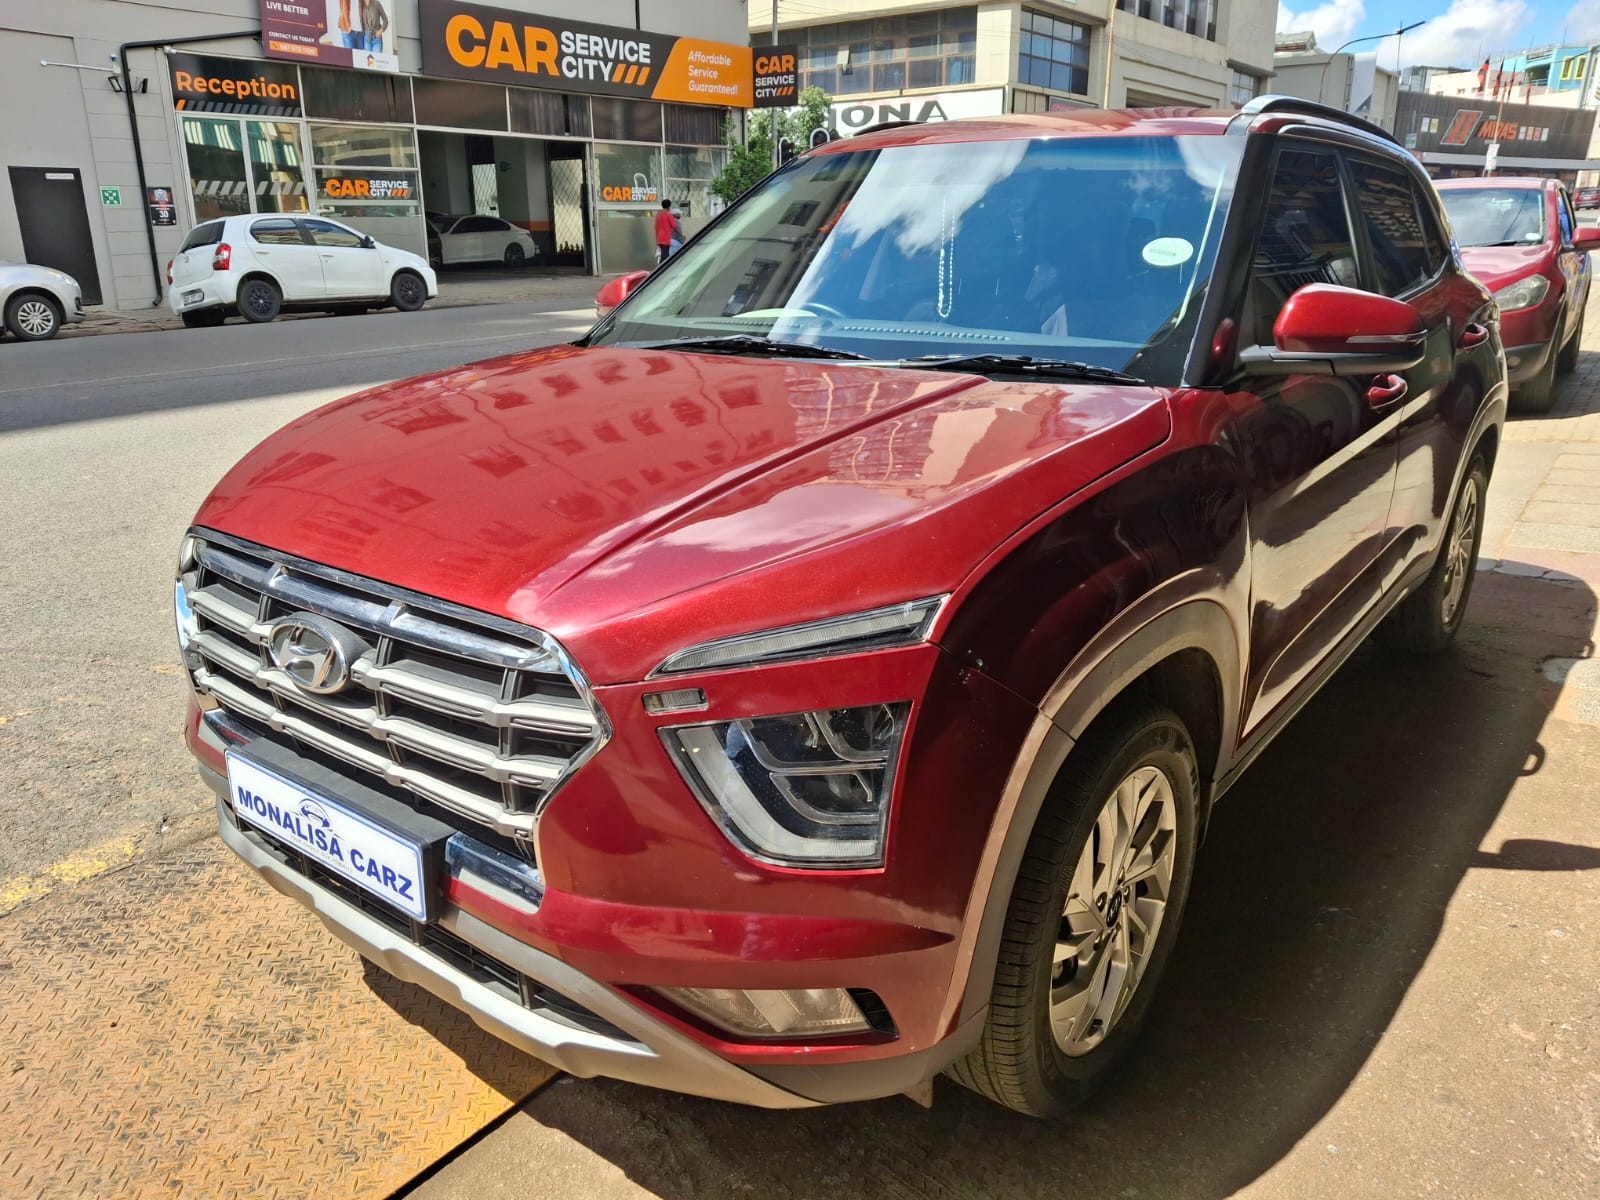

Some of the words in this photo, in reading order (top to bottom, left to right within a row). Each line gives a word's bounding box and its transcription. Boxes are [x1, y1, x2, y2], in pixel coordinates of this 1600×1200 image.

[266, 1, 282, 11] LIVE
[283, 4, 309, 15] BETTER
[268, 31, 291, 39] CONTACT
[445, 14, 560, 76] CAR
[560, 31, 651, 63] SERVICE
[688, 50, 732, 66] Affordable
[755, 55, 795, 74] CAR
[561, 56, 613, 82] CITY
[688, 65, 718, 79] Service
[175, 71, 296, 100] Reception
[688, 80, 738, 95] Guaranteed!
[755, 75, 795, 87] SERVICE
[755, 88, 777, 98] CITY
[325, 178, 370, 198] CAR
[369, 180, 409, 189] SERVICE
[370, 188, 392, 197] CITY
[603, 186, 632, 201] CAR
[237, 786, 344, 862] MONALISA
[350, 848, 414, 901] CARZ
